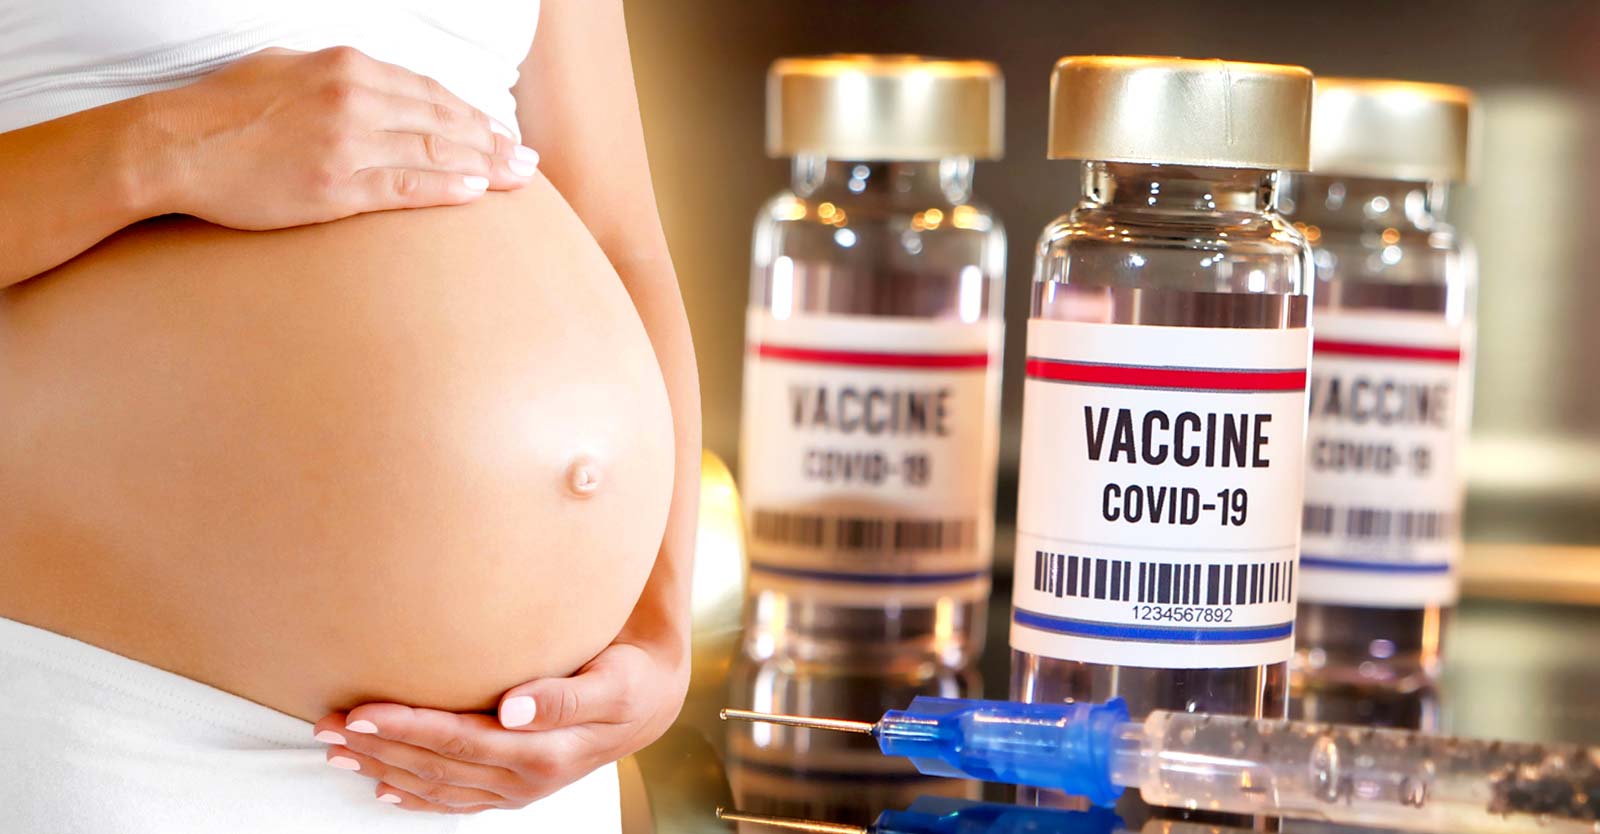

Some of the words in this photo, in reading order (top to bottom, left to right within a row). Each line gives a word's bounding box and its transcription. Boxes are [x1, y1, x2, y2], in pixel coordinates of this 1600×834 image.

[790, 386, 953, 436] VACCINE
[1084, 406, 1272, 468] VACCINE
[1102, 483, 1249, 526] COVID-19
[1132, 605, 1233, 623] 1234567892
